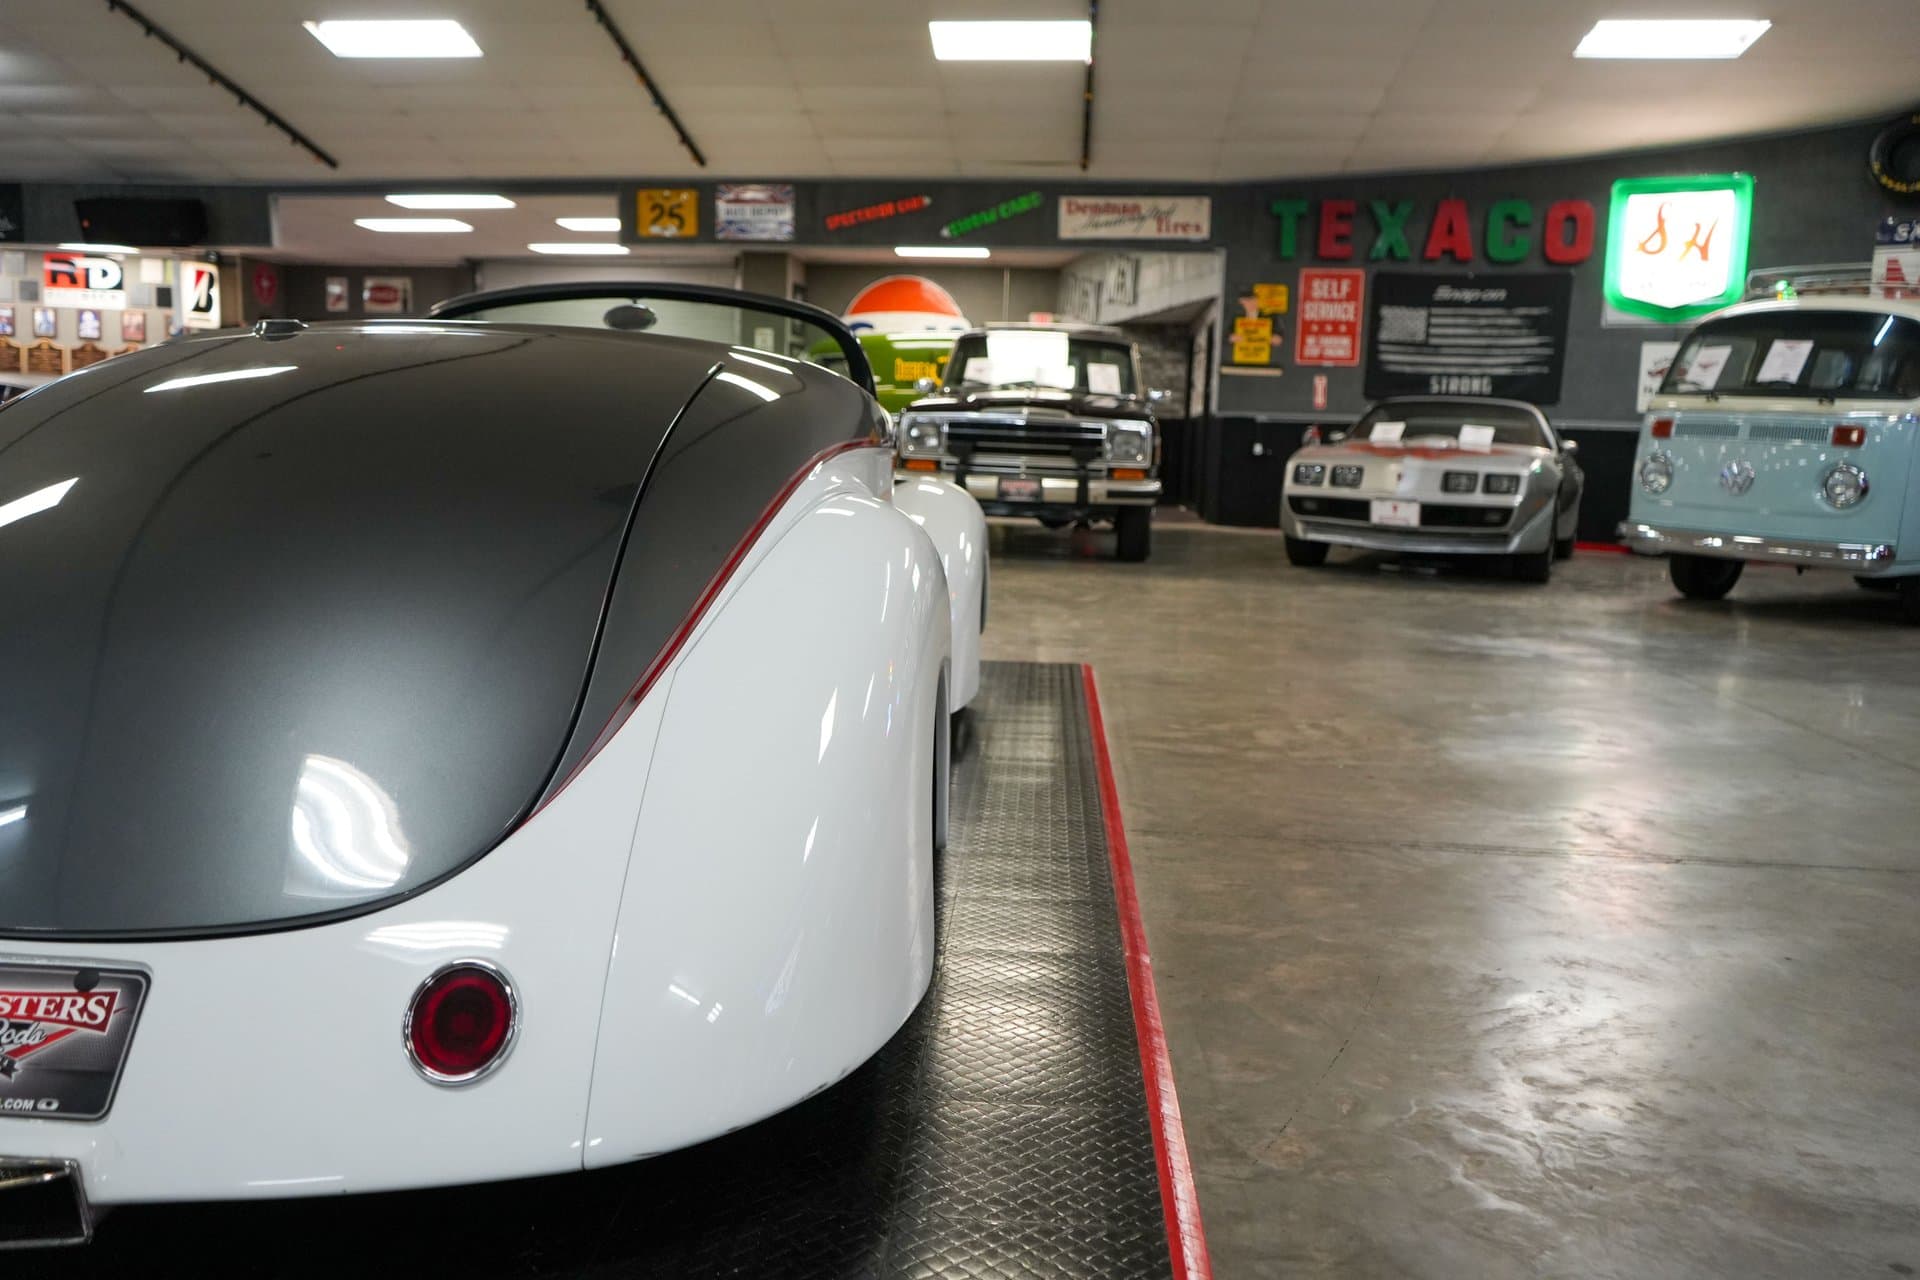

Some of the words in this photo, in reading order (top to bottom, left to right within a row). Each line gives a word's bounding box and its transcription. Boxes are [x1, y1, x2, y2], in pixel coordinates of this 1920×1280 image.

[650, 202, 684, 231] 25
[1271, 198, 1596, 264] TEXACO
[1311, 278, 1352, 299] SELF
[1303, 301, 1356, 321] SERVICE
[1430, 375, 1492, 395] STRONG
